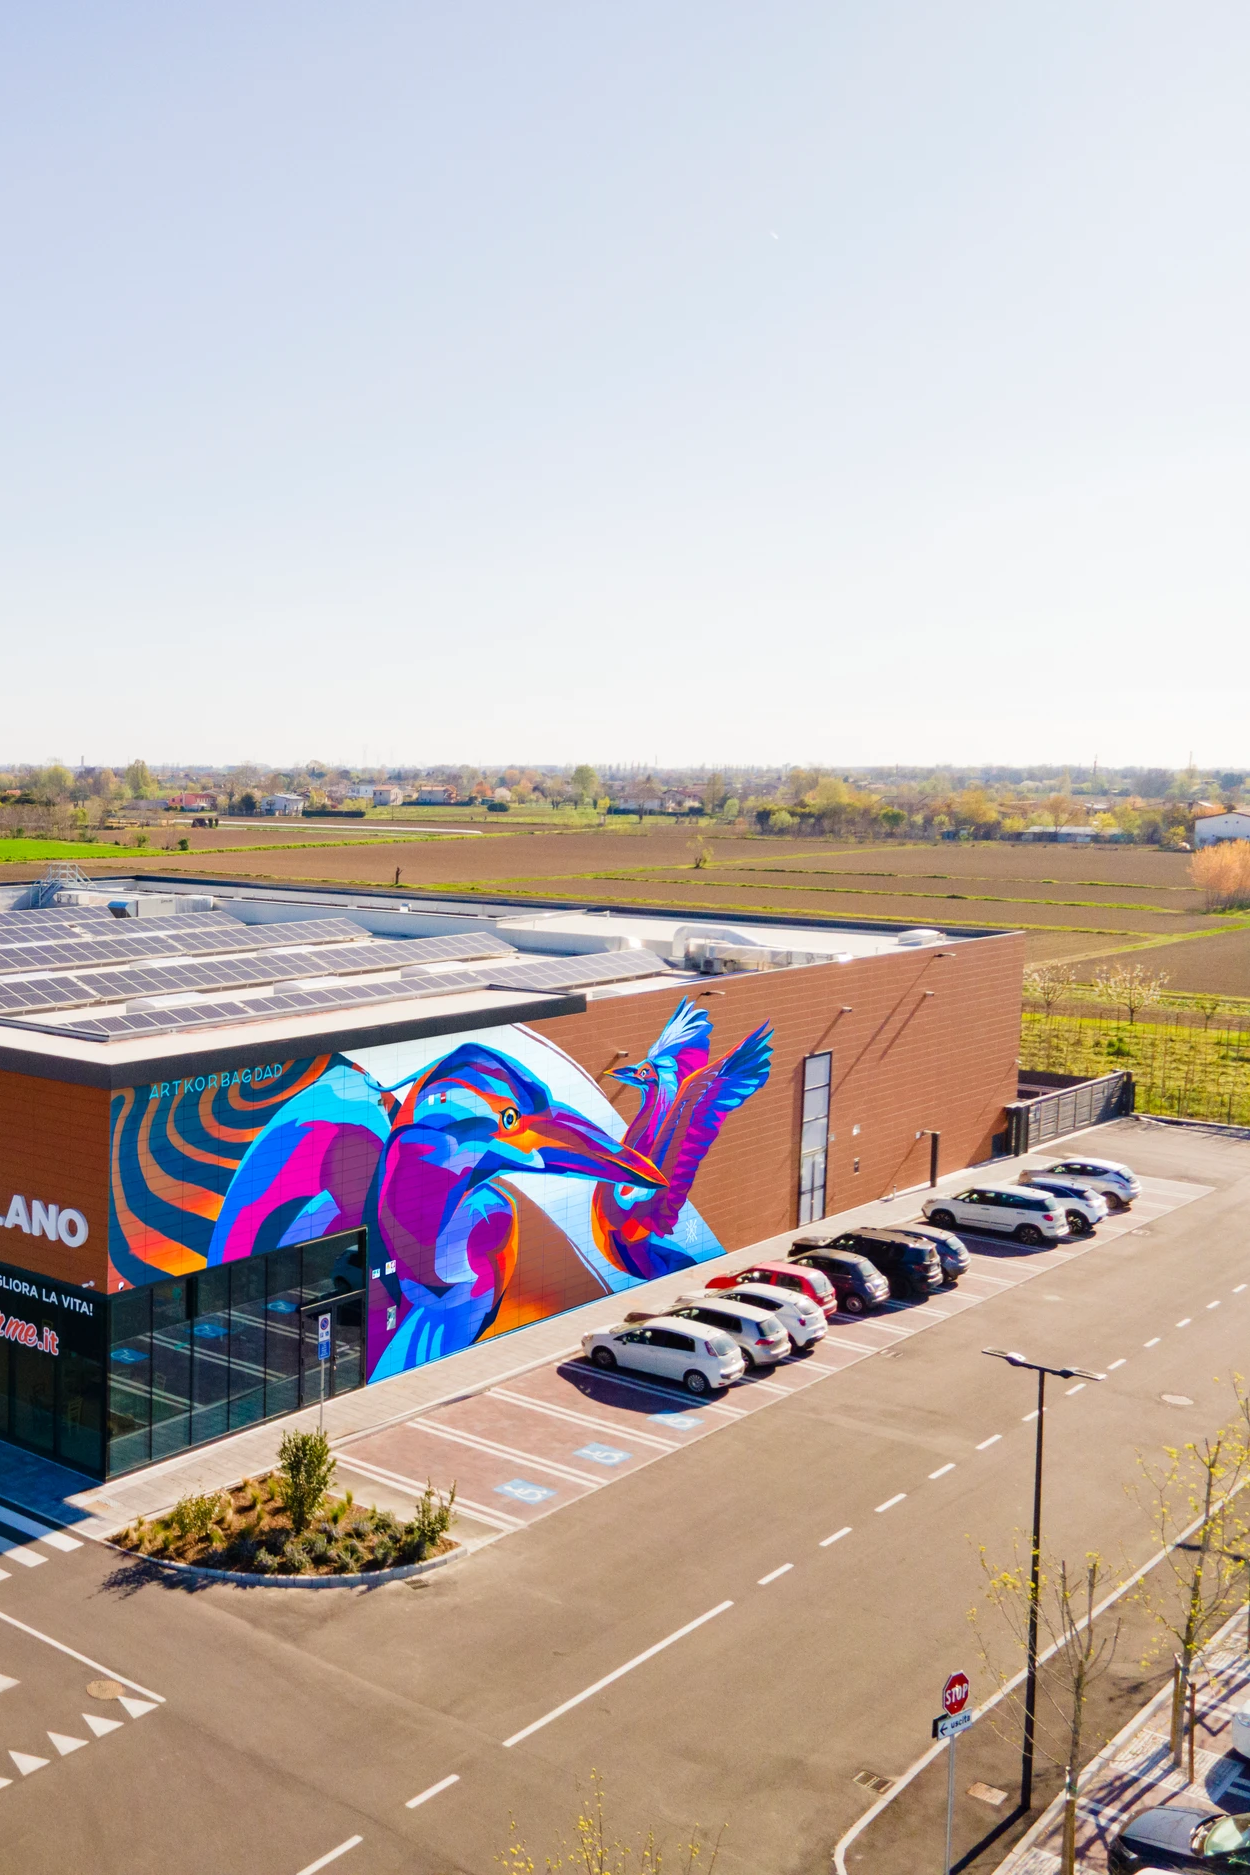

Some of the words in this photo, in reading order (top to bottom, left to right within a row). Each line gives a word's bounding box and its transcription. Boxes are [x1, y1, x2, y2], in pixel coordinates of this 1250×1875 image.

[42, 1288, 59, 1305] LA
[61, 1294, 94, 1316] VITA!
[945, 1683, 968, 1705] STOP
[951, 1715, 970, 1728] uscita
